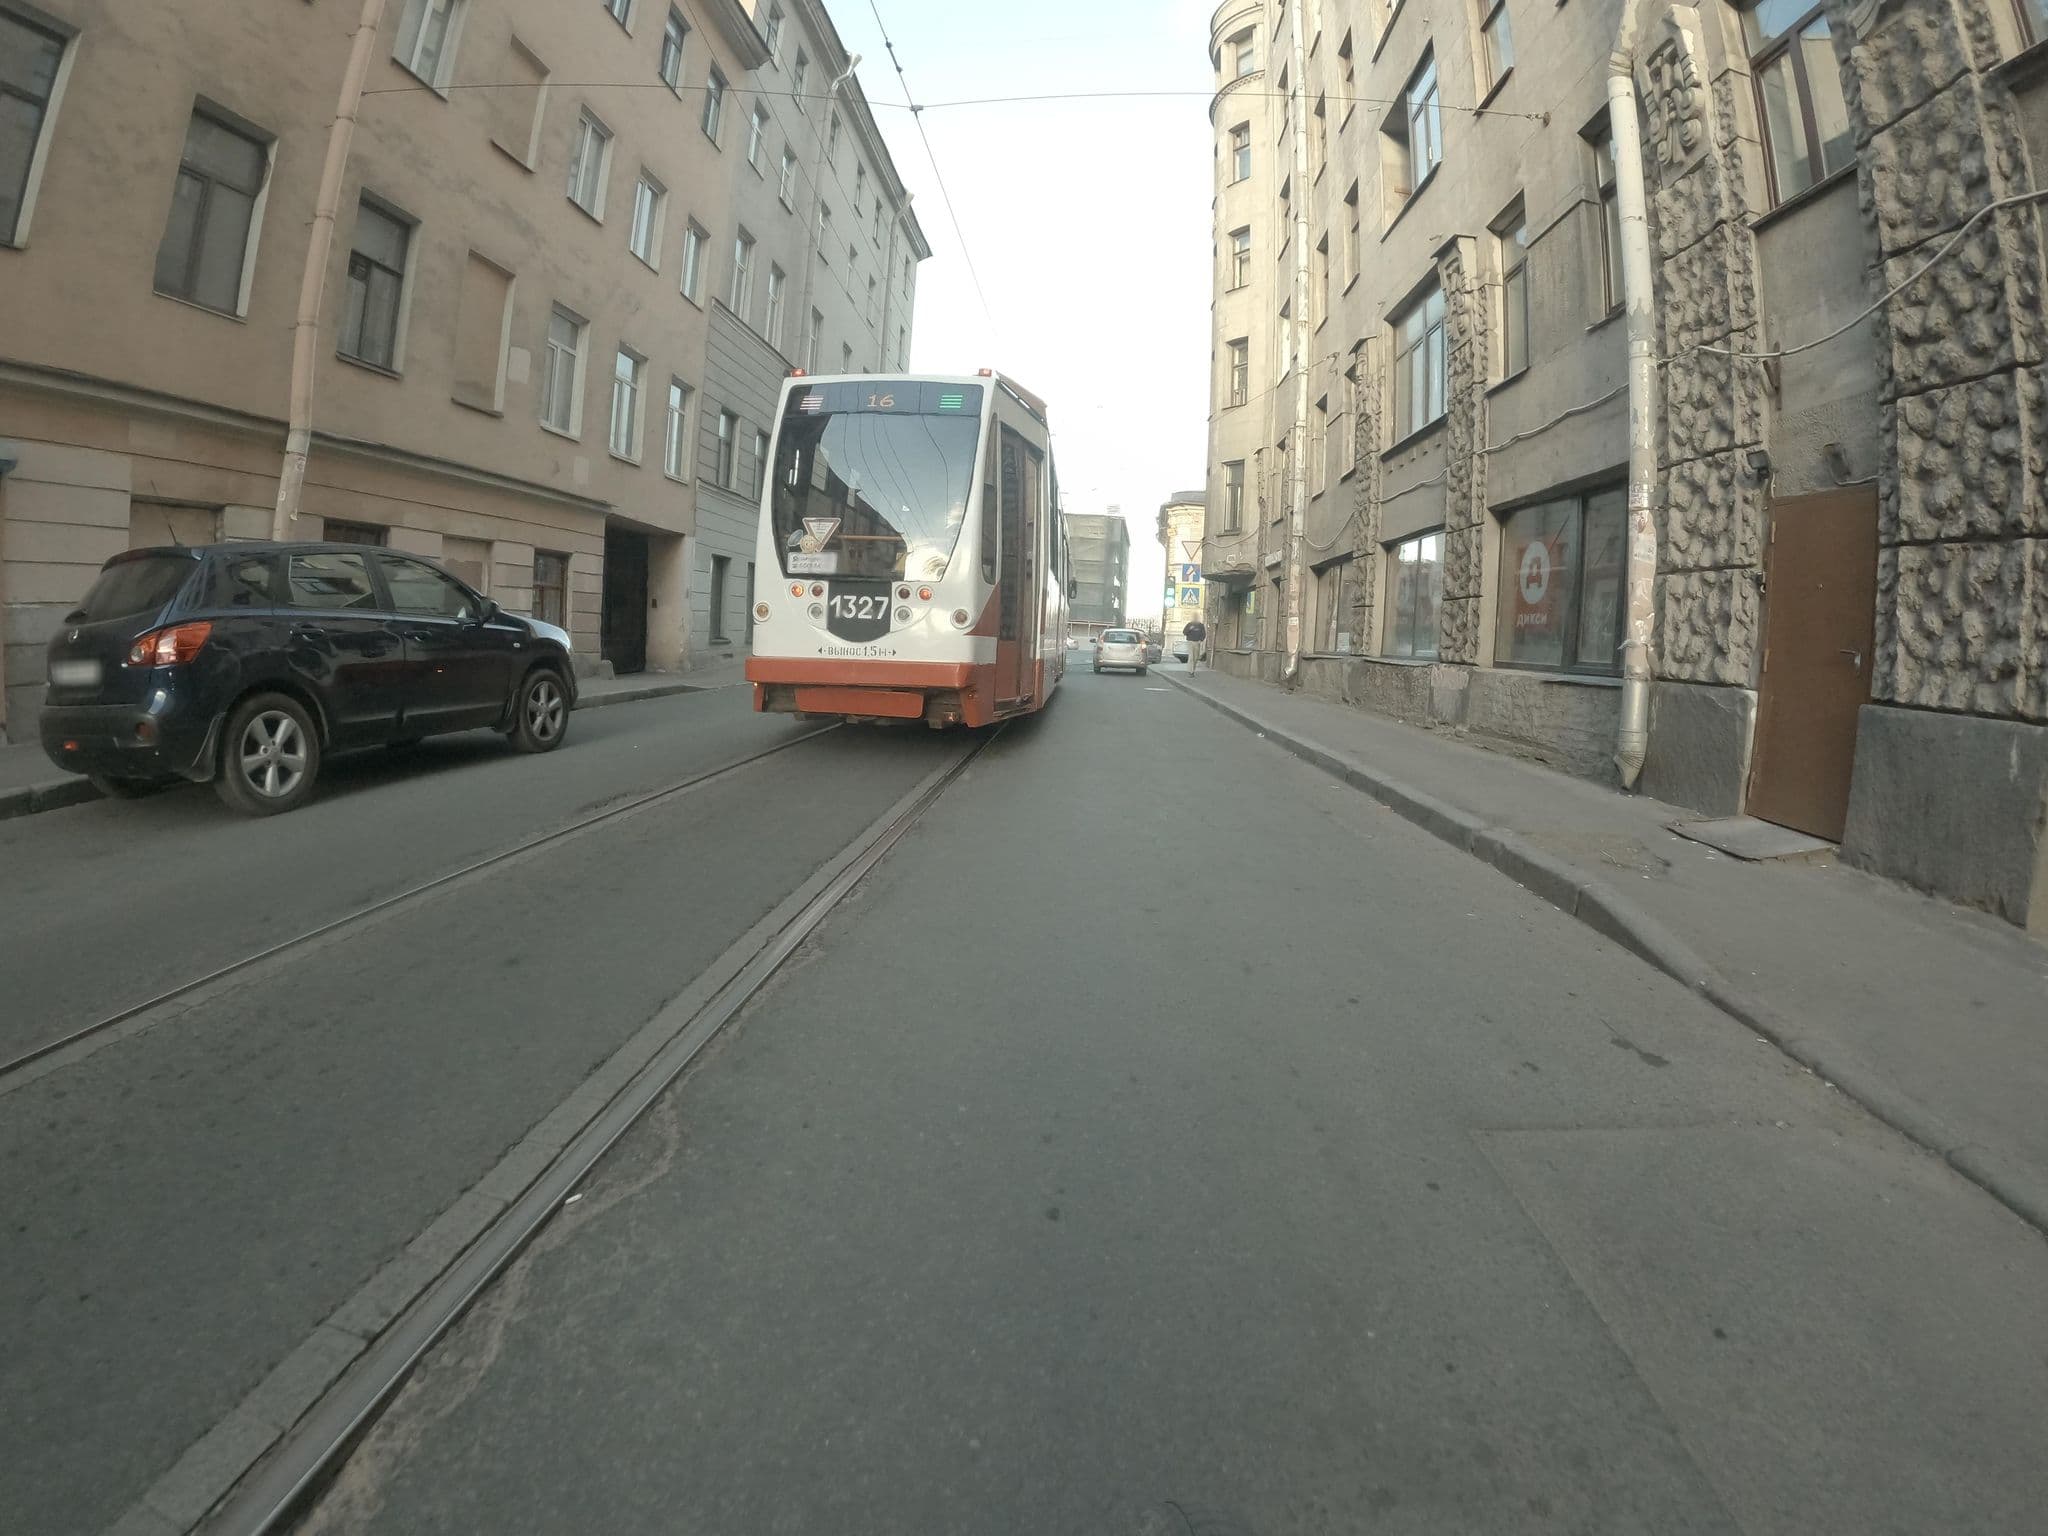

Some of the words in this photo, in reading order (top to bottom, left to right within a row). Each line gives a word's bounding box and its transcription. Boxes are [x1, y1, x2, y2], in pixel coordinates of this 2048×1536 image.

[867, 394, 895, 408] 16
[830, 595, 889, 620] 1327
[828, 646, 862, 657] ВЫНОС
